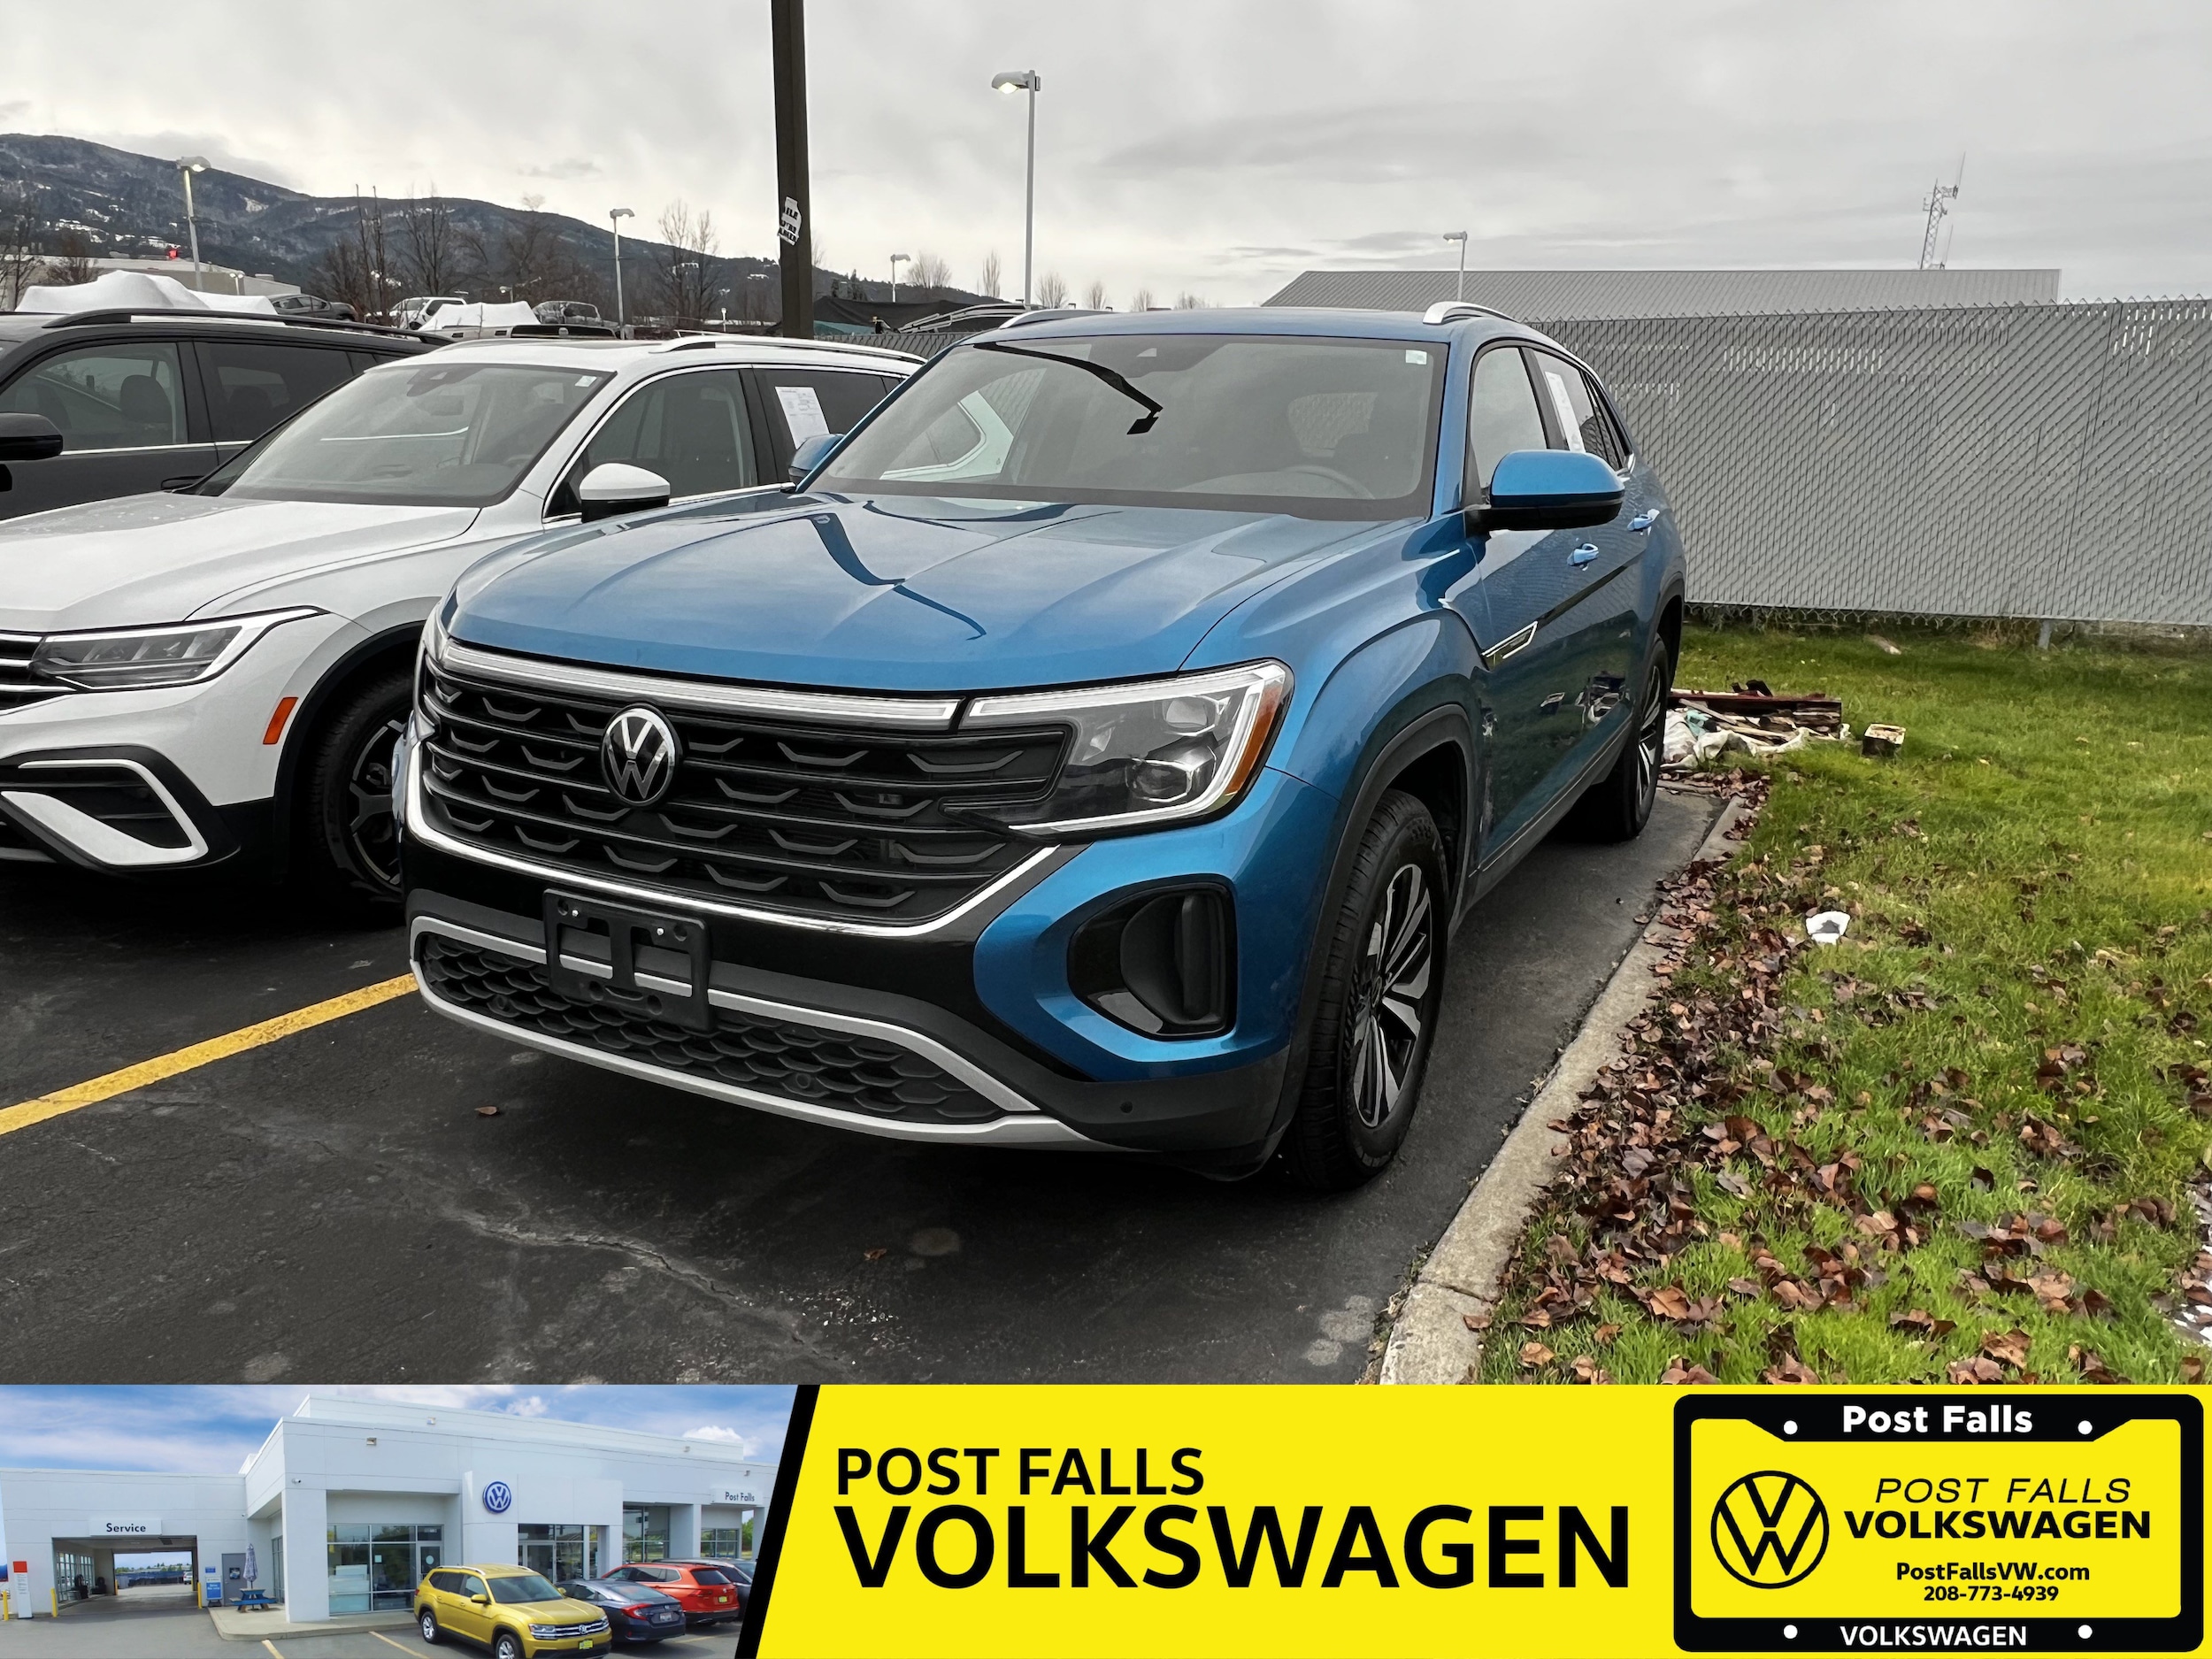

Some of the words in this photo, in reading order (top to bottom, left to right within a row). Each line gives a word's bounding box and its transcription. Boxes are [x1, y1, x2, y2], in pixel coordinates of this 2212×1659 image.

[725, 1492, 739, 1501] Post
[740, 1493, 755, 1502] Falls
[106, 1523, 146, 1532] Service
